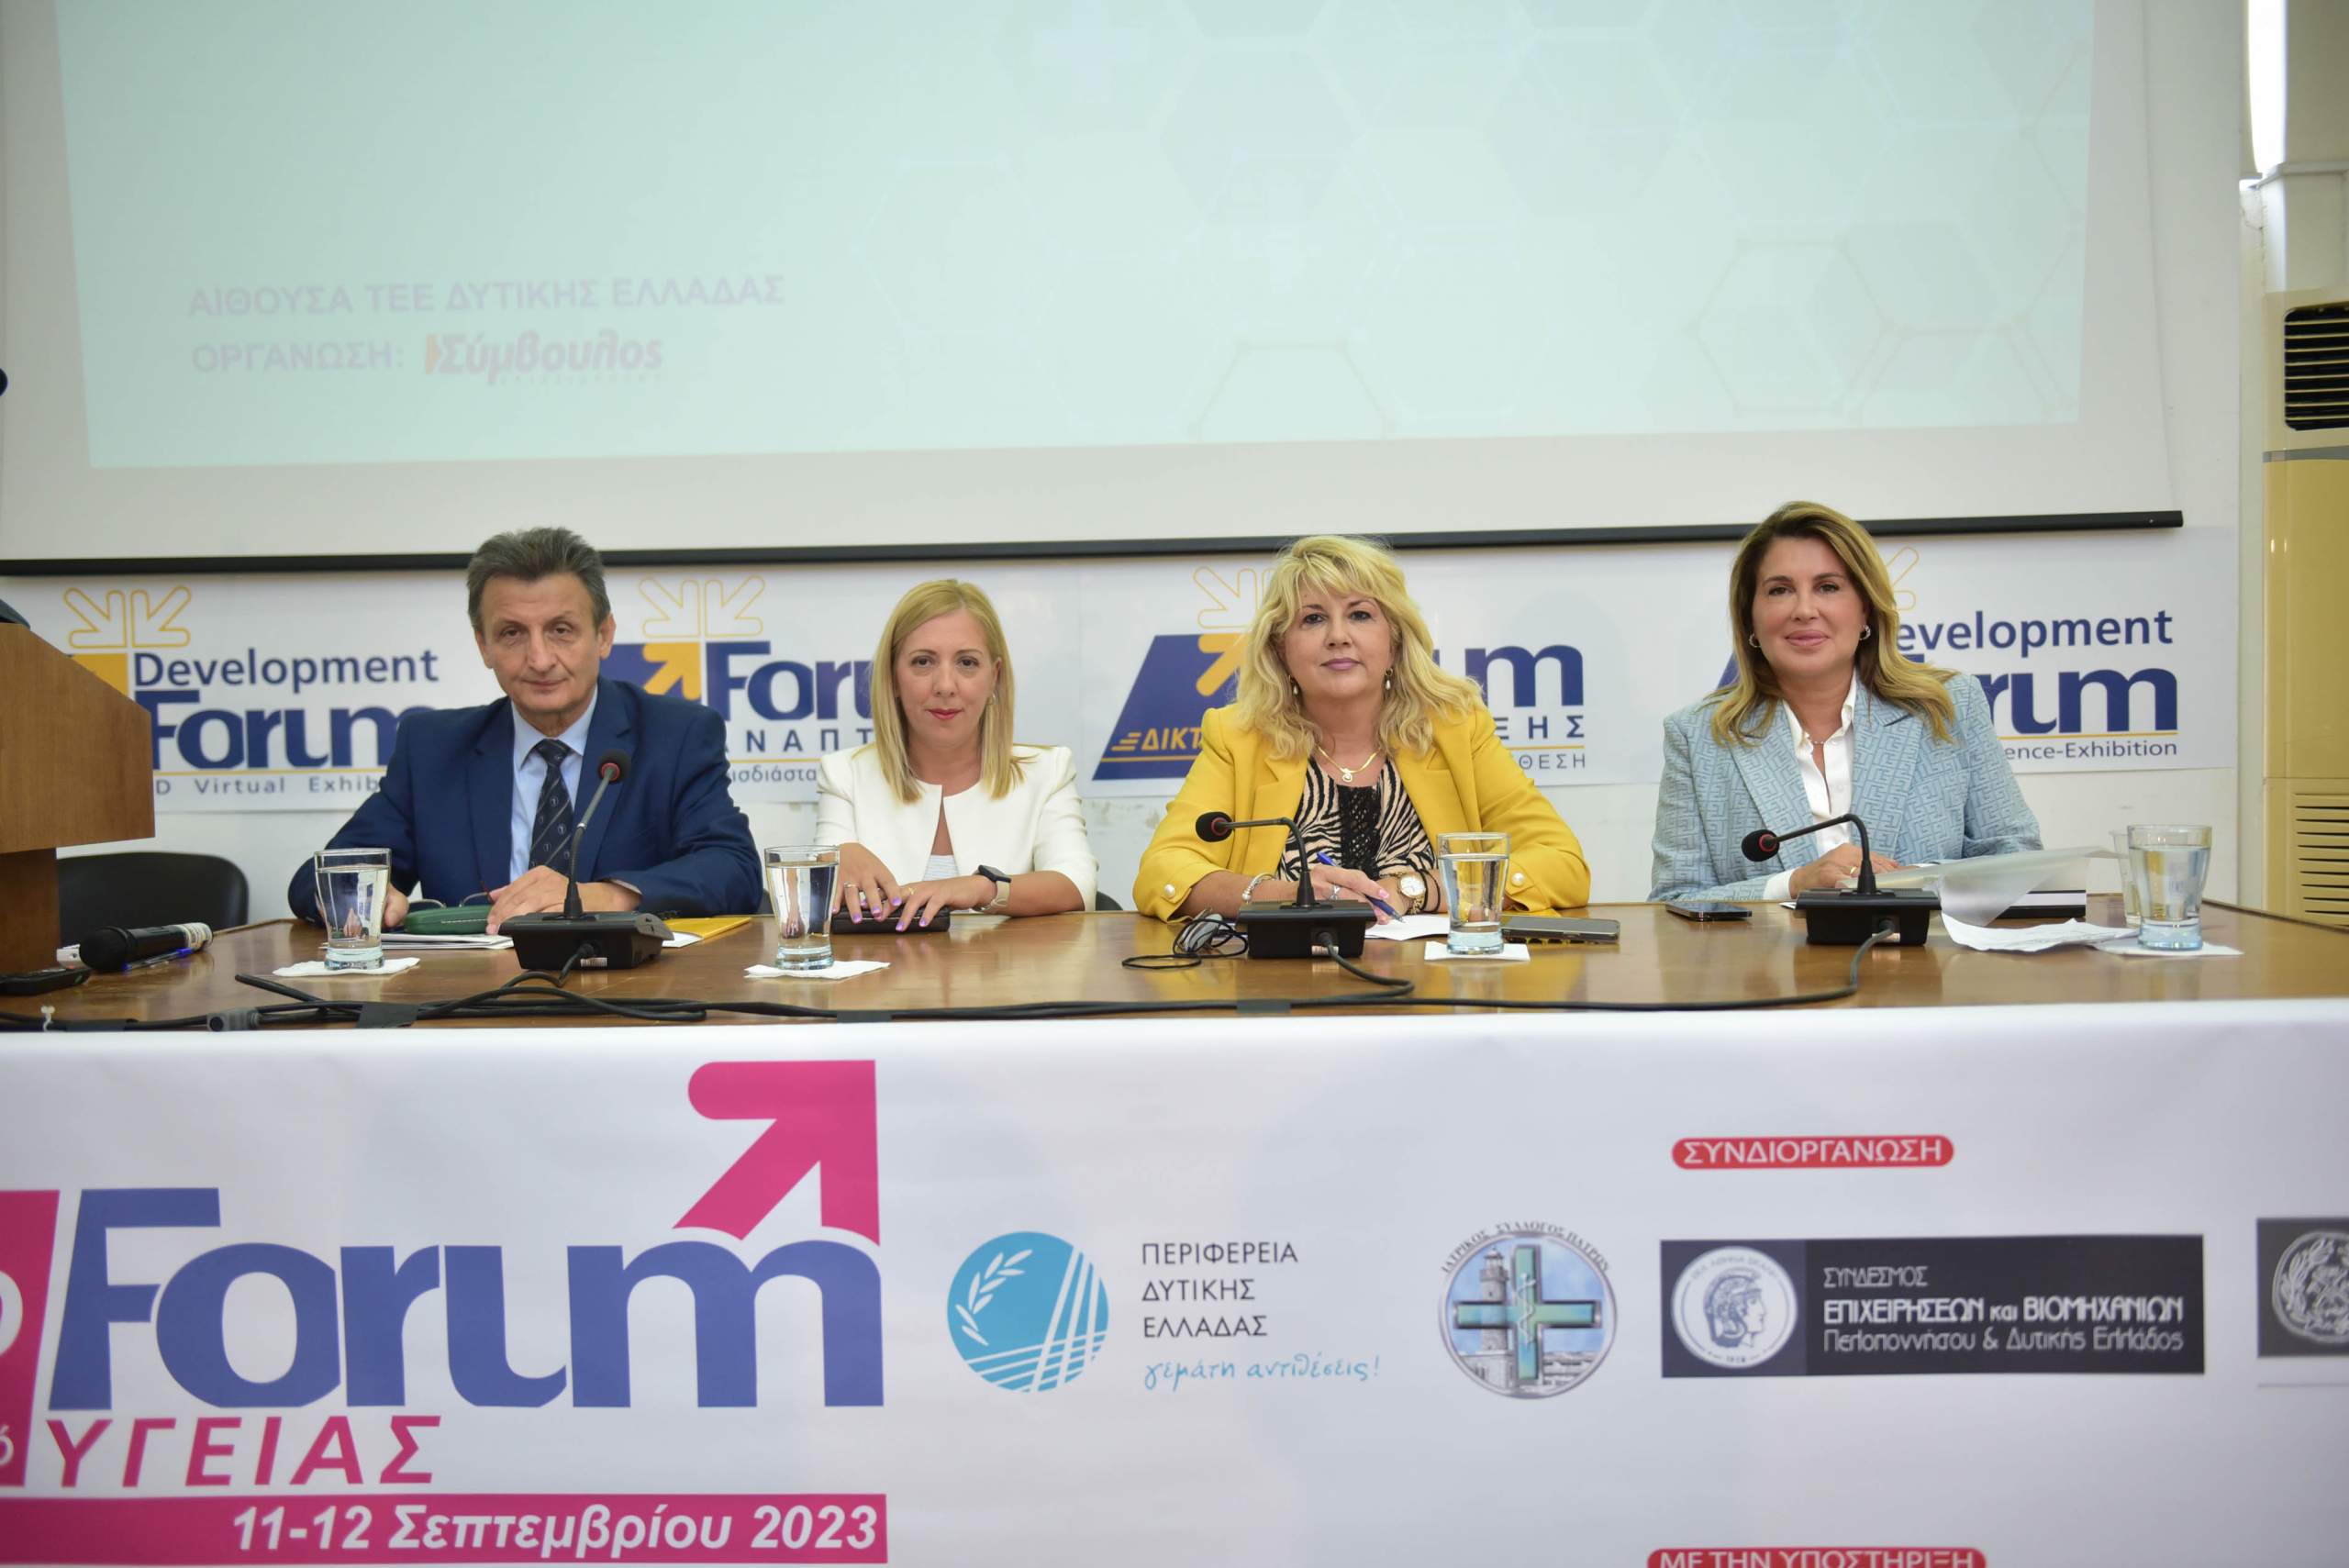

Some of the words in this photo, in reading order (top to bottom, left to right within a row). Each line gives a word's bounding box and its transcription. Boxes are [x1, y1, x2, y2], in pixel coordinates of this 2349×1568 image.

[188, 284, 354, 317] ΑΙΘΟΥΣΑ
[364, 283, 434, 312] ΤΕΕ
[445, 278, 600, 312] ΔΥΤΙΚΗΣ
[612, 274, 785, 308] ΕΛΛΑΔΑΣ
[190, 339, 405, 373] ΟΡΓΑΝΩΣΗ:
[1897, 609, 2175, 659] evelopment
[134, 648, 440, 695] Development
[723, 728, 874, 753] ΝΑΠΤ
[194, 776, 285, 794] Virtual
[1683, 1139, 1943, 1165] ΣΥΝΔΙΟΡΓΑΝΩΣΗ
[1142, 1241, 1298, 1264] ΠΕΡΙΦΕΡΕΙΑ
[1141, 1278, 1256, 1302] ΔΥΤΙΚΗΣ
[1823, 1266, 1929, 1288] ΣΥΝΔΕΣΜΟΣ
[48, 1187, 885, 1410] Forum
[1823, 1297, 1985, 1324] ΕΠΙΧΕΙΡΗΣΕΩΝ
[1989, 1305, 2018, 1321] και
[2022, 1296, 2184, 1323] ΒΙΟΜΗΧΑΝΙΩΝ
[1143, 1315, 1268, 1338] ΕΛΛΑΔΑΣ
[1982, 1327, 1998, 1351] &
[1144, 1359, 1235, 1393] γεμάτη
[46, 1416, 441, 1488] ΥΓΕΙΑΣ
[234, 1506, 373, 1551] 11-12
[388, 1504, 732, 1559] Σεπτεμβρίου
[751, 1505, 877, 1550] 2023
